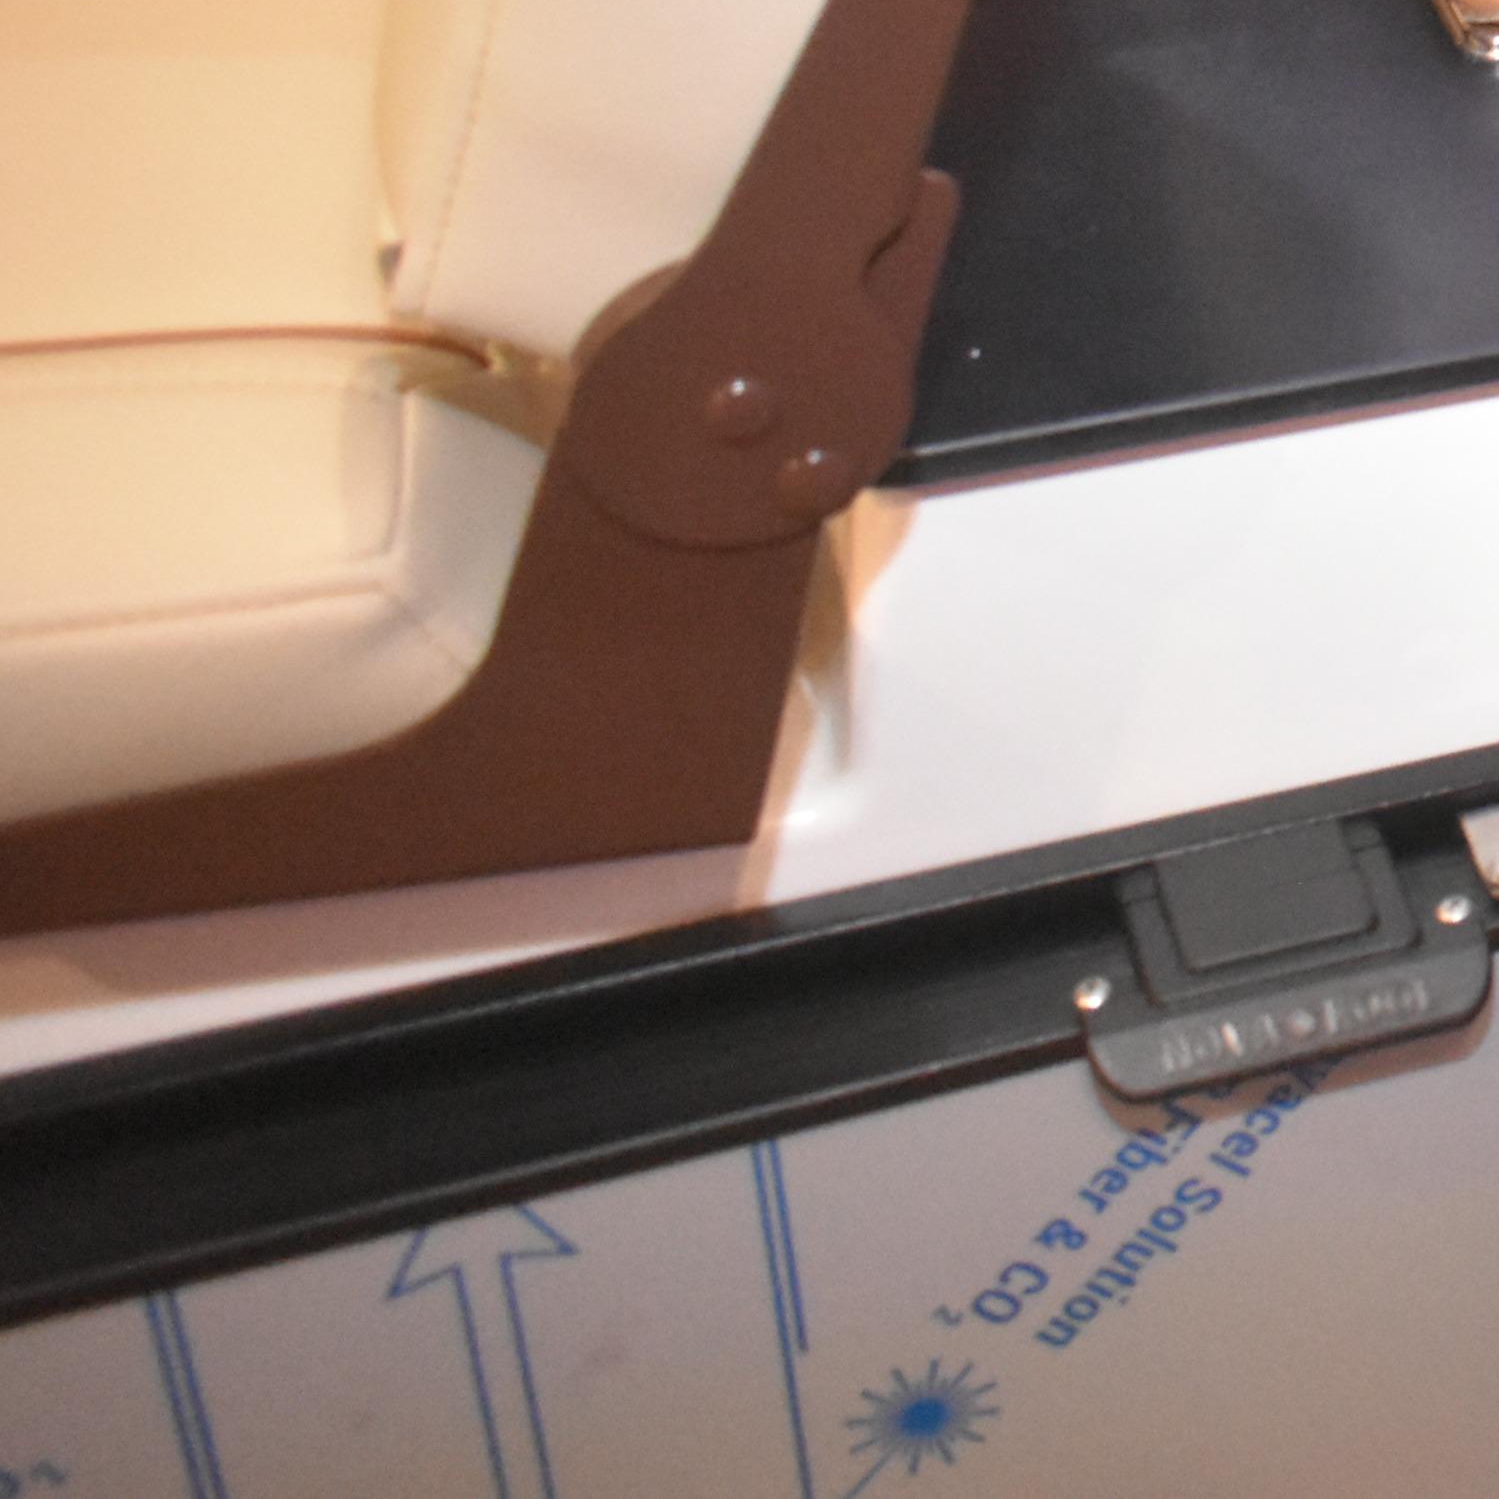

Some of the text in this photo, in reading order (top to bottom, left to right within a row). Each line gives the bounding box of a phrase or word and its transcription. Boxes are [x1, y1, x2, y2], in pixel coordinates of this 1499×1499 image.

[1078, 1100, 1204, 1214] Fiber
[1033, 1218, 1088, 1251] &
[1033, 1177, 1223, 1348] Solution
